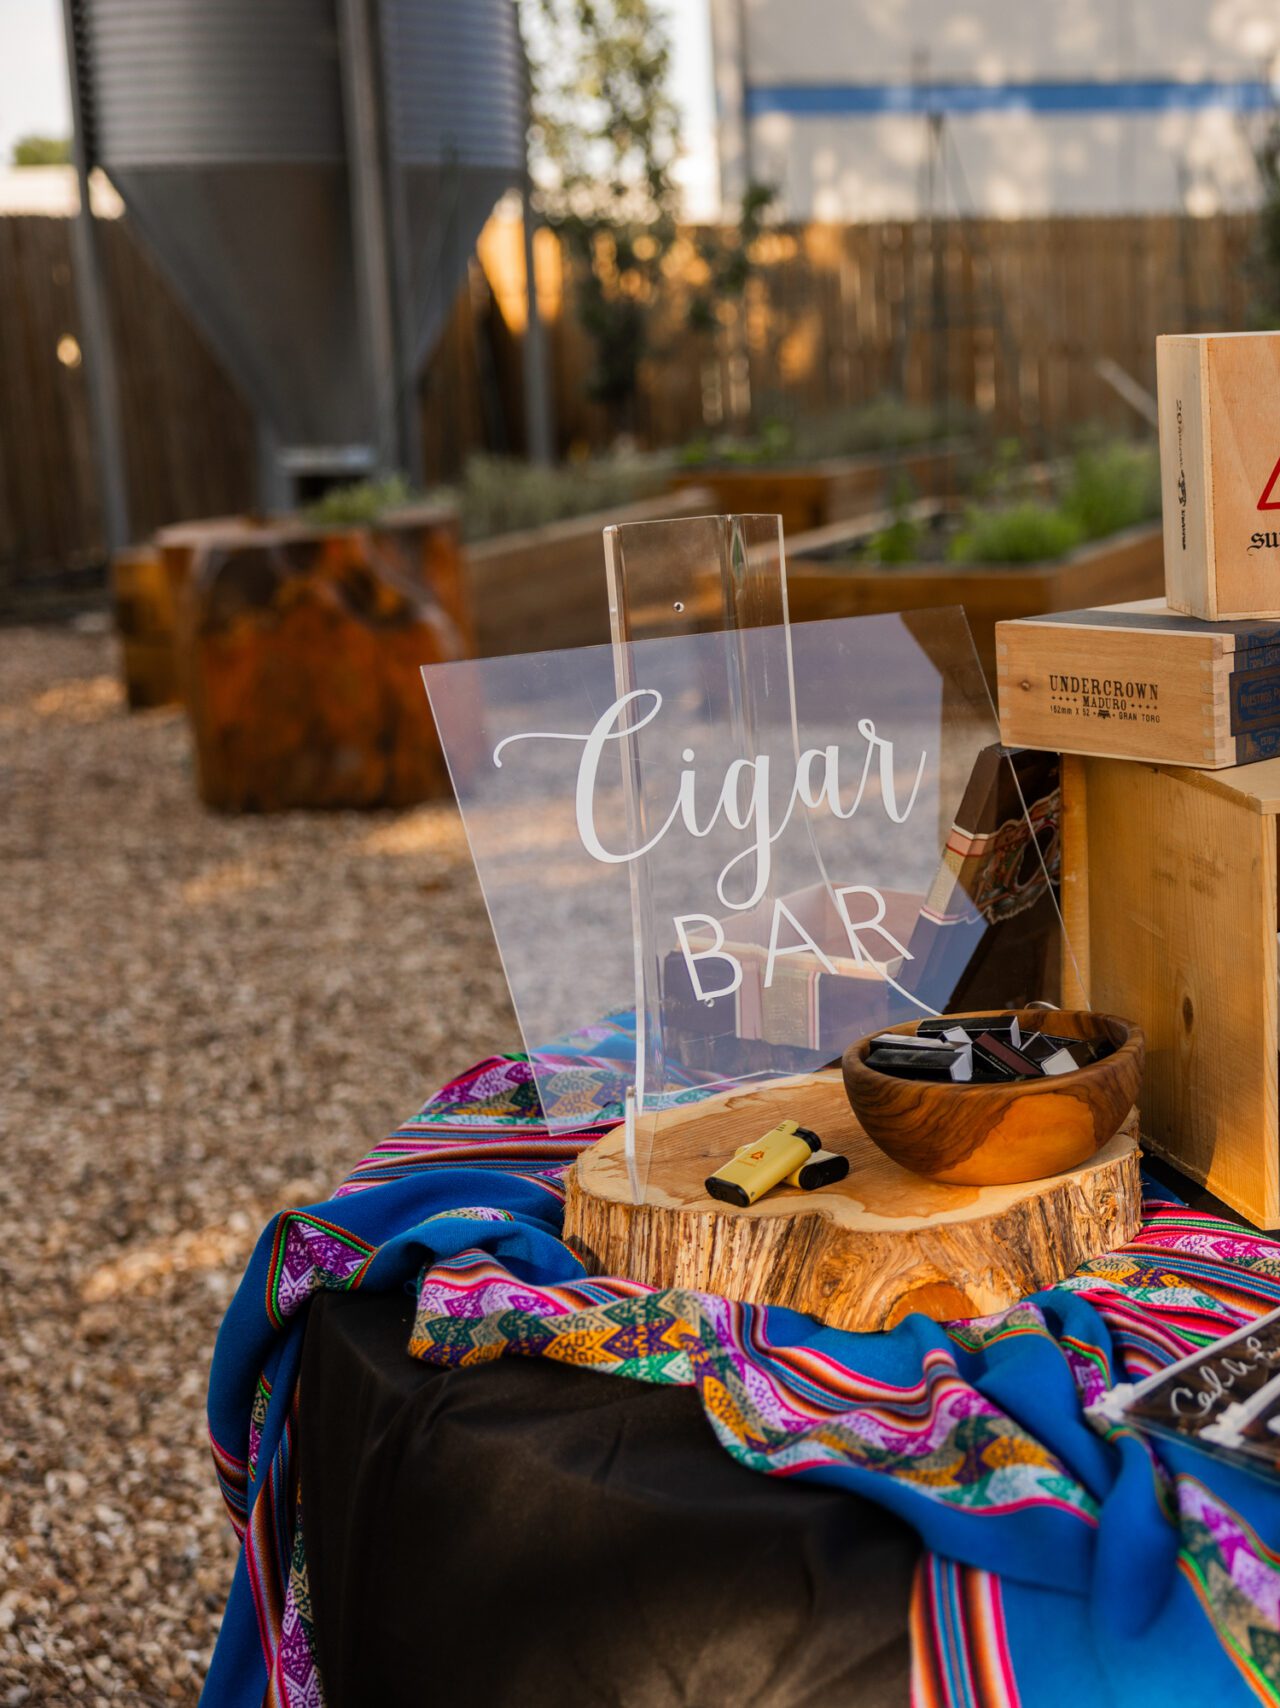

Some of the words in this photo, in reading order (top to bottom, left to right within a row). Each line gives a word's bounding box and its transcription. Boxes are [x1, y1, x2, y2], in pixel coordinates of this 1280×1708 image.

[1049, 674, 1158, 700] UNDERCROWN
[1083, 696, 1127, 711] MADURO
[1119, 711, 1137, 720] GRAN
[494, 689, 927, 910] Cigar
[672, 885, 915, 1003] BAR
